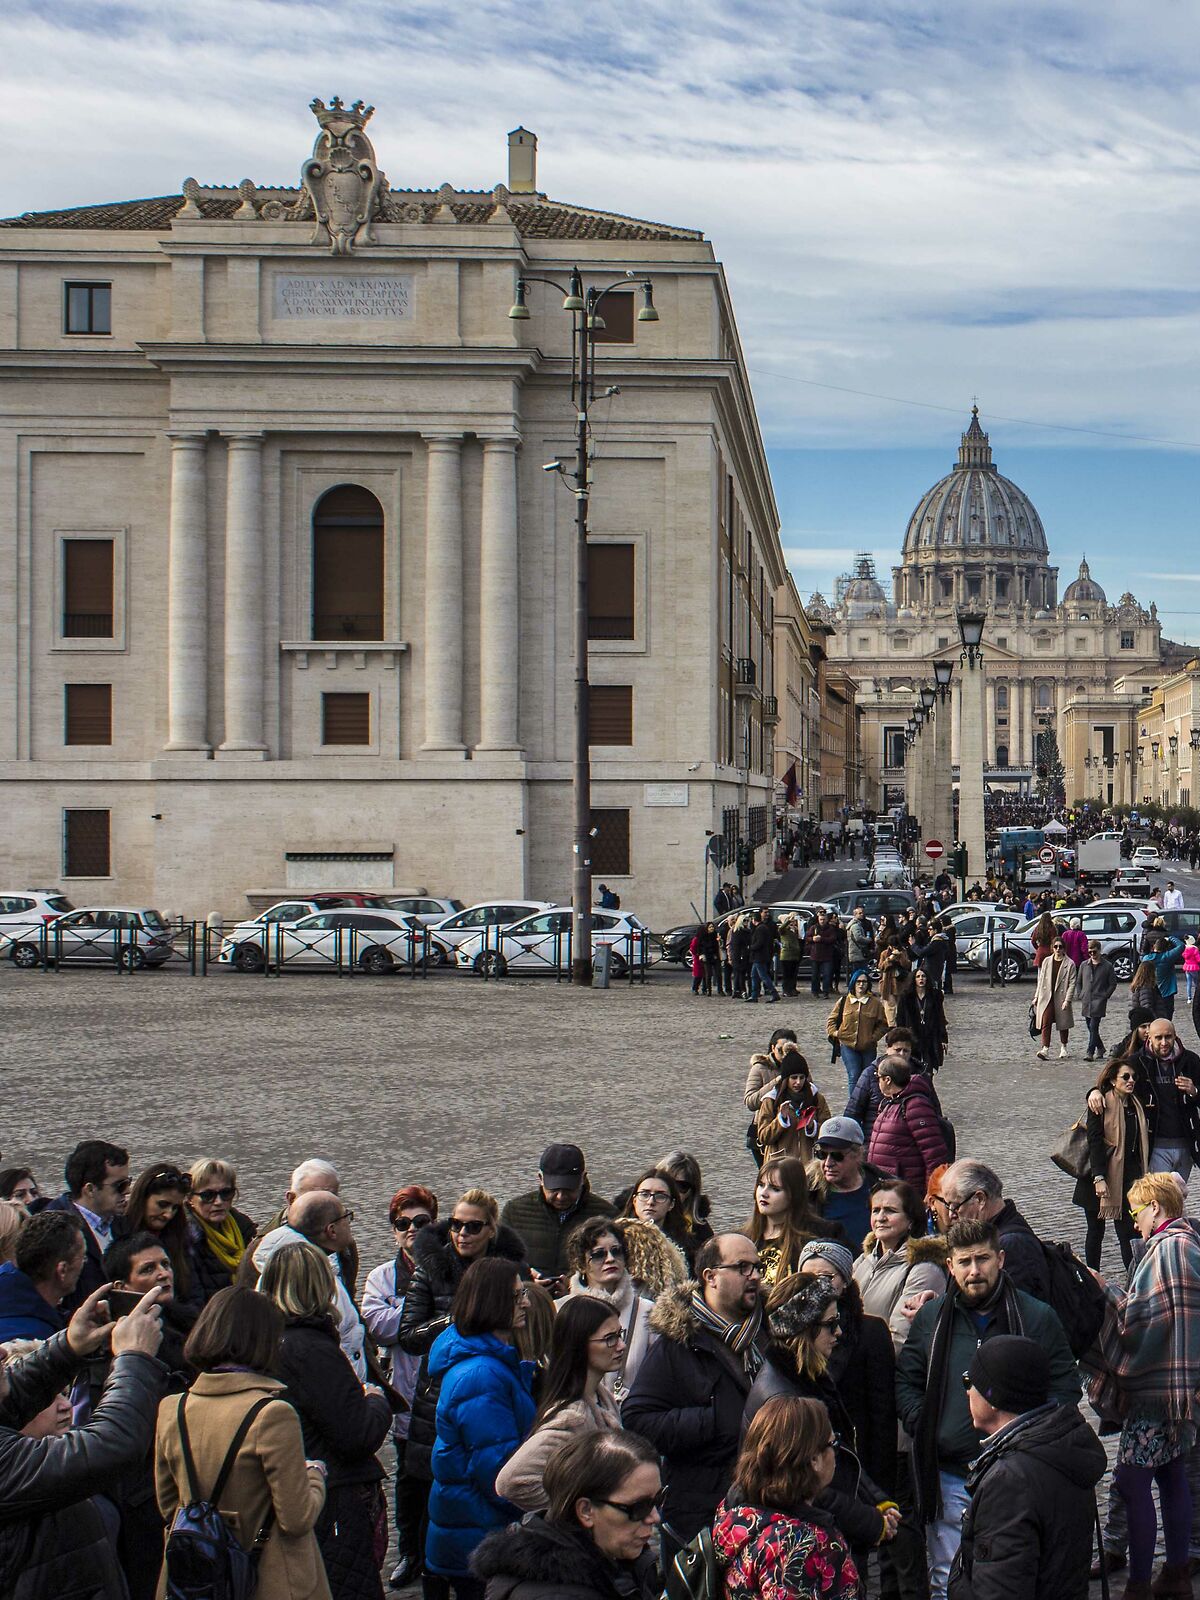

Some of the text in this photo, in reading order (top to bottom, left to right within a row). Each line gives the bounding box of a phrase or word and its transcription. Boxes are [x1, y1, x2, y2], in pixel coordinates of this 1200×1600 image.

[287, 280, 403, 290] ADITVS AD MAXIMVM
[281, 289, 408, 299] CHRISTIANORVM TEMPLVM
[354, 299, 409, 307] INCHOATVS
[343, 307, 404, 316] ABSOLVTVS
